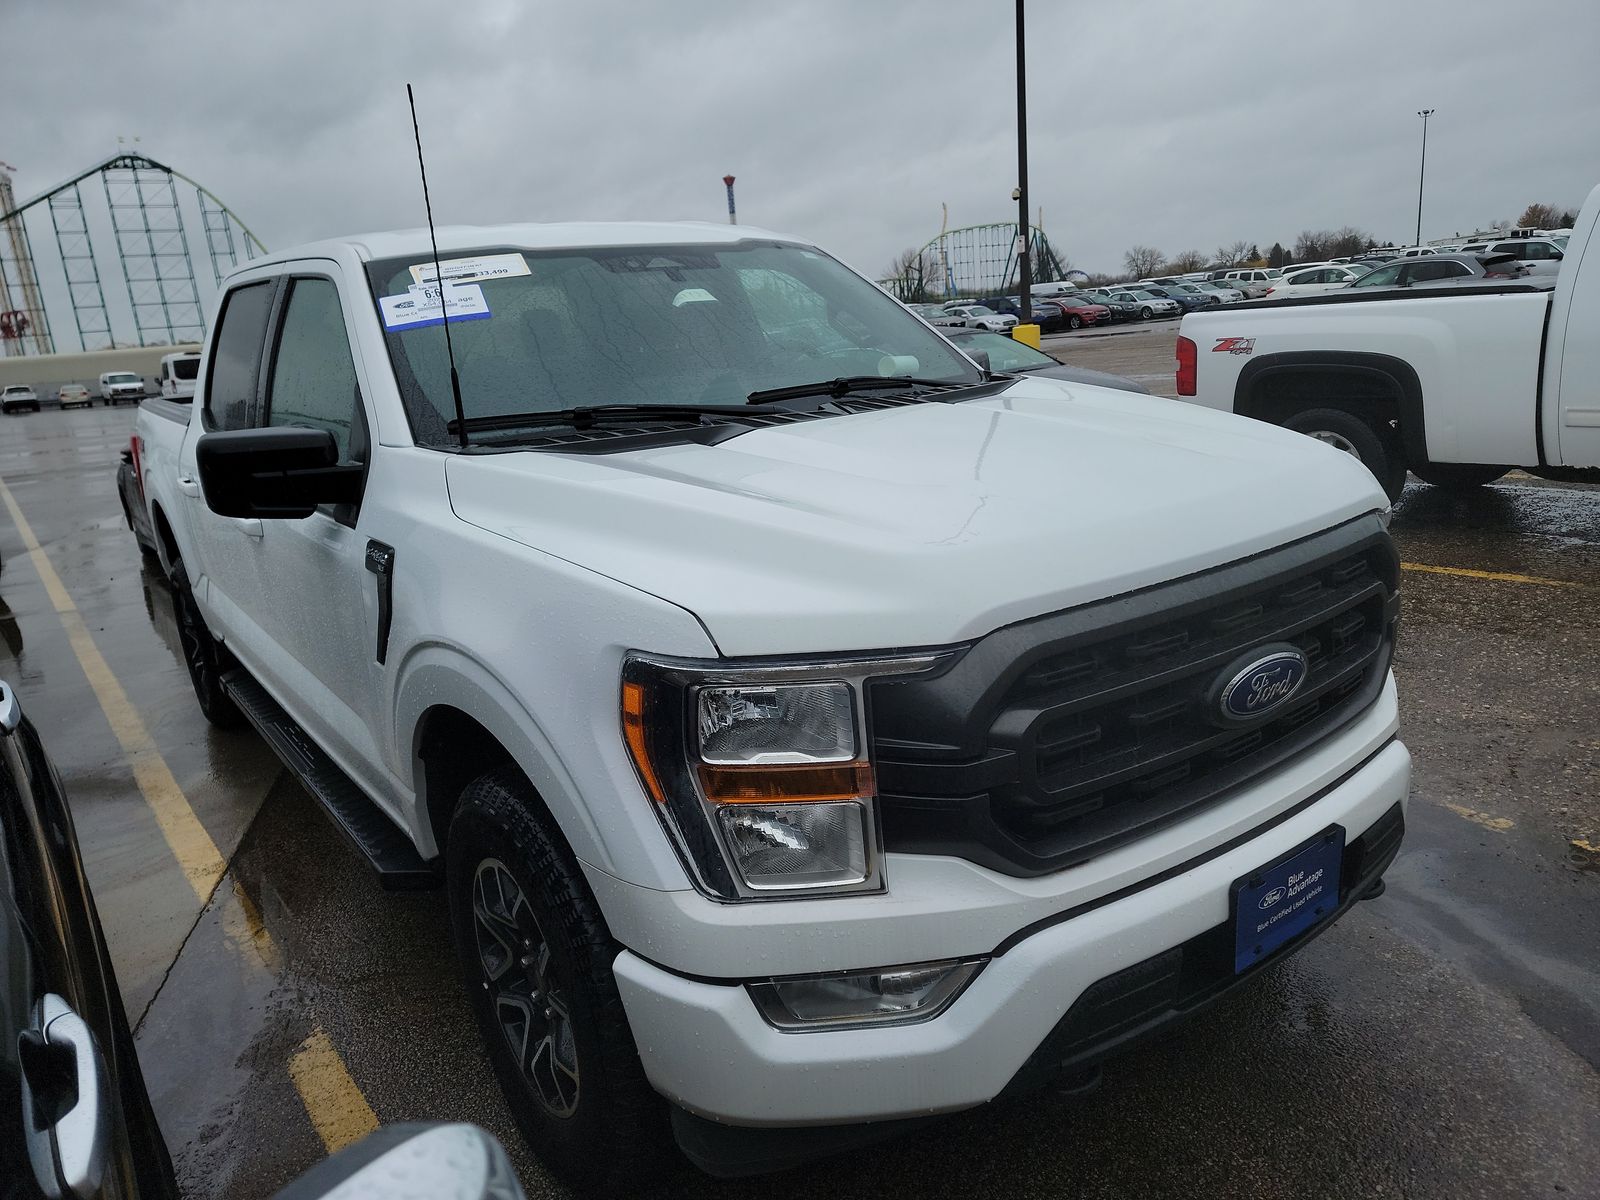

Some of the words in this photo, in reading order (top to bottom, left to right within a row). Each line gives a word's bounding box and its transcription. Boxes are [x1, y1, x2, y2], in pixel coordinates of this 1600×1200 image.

[1246, 667, 1292, 709] Ford
[1286, 868, 1323, 899] Advantage
[1288, 871, 1304, 887] Blue
[1257, 920, 1270, 933] Blue
[1269, 904, 1293, 924] Certified
[1292, 896, 1306, 910] Used
[1305, 885, 1323, 901] Vehicle
[1262, 889, 1282, 907] Ford
